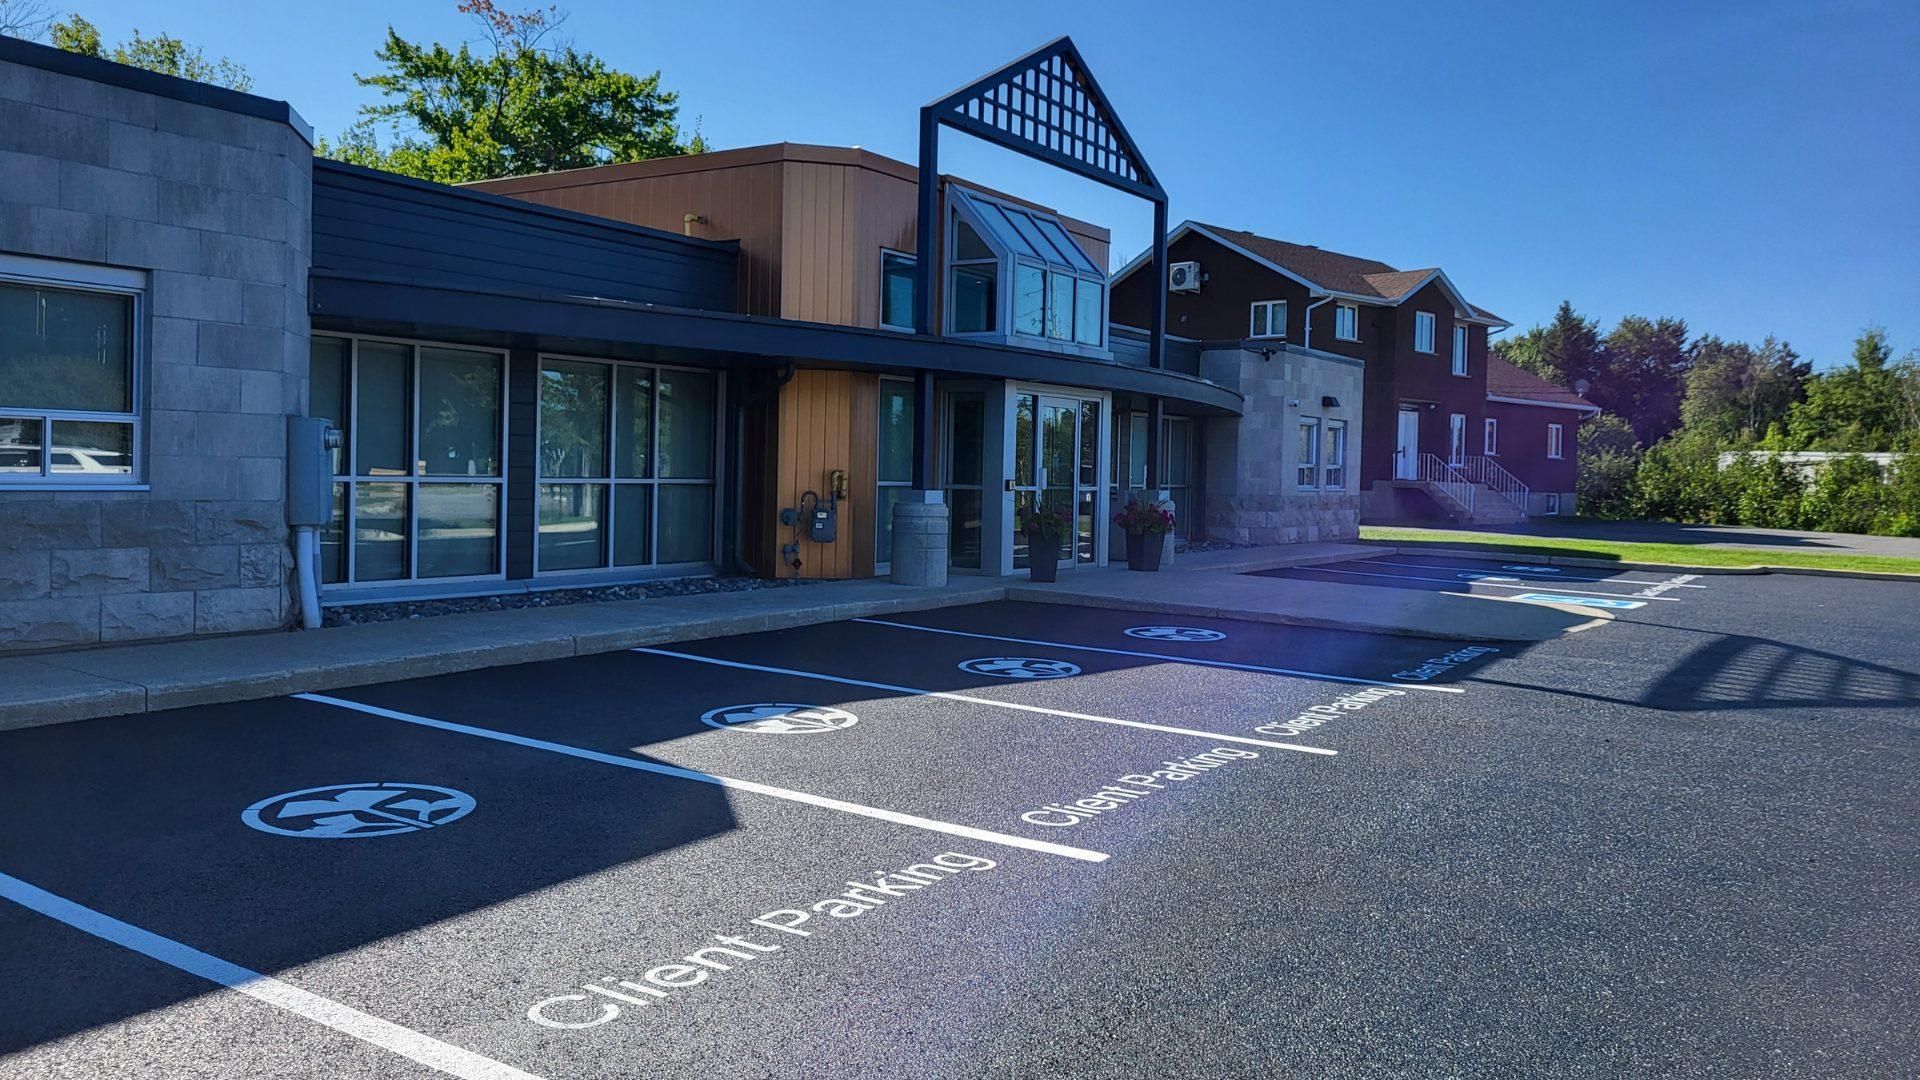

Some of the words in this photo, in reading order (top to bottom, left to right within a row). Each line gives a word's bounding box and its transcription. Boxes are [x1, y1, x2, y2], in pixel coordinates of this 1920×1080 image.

[1255, 712, 1340, 736] Client
[1308, 688, 1406, 715] Parking
[1021, 785, 1151, 827] Client
[1116, 747, 1260, 789] Parking
[527, 934, 782, 1030] Client
[750, 851, 998, 937] Parking
